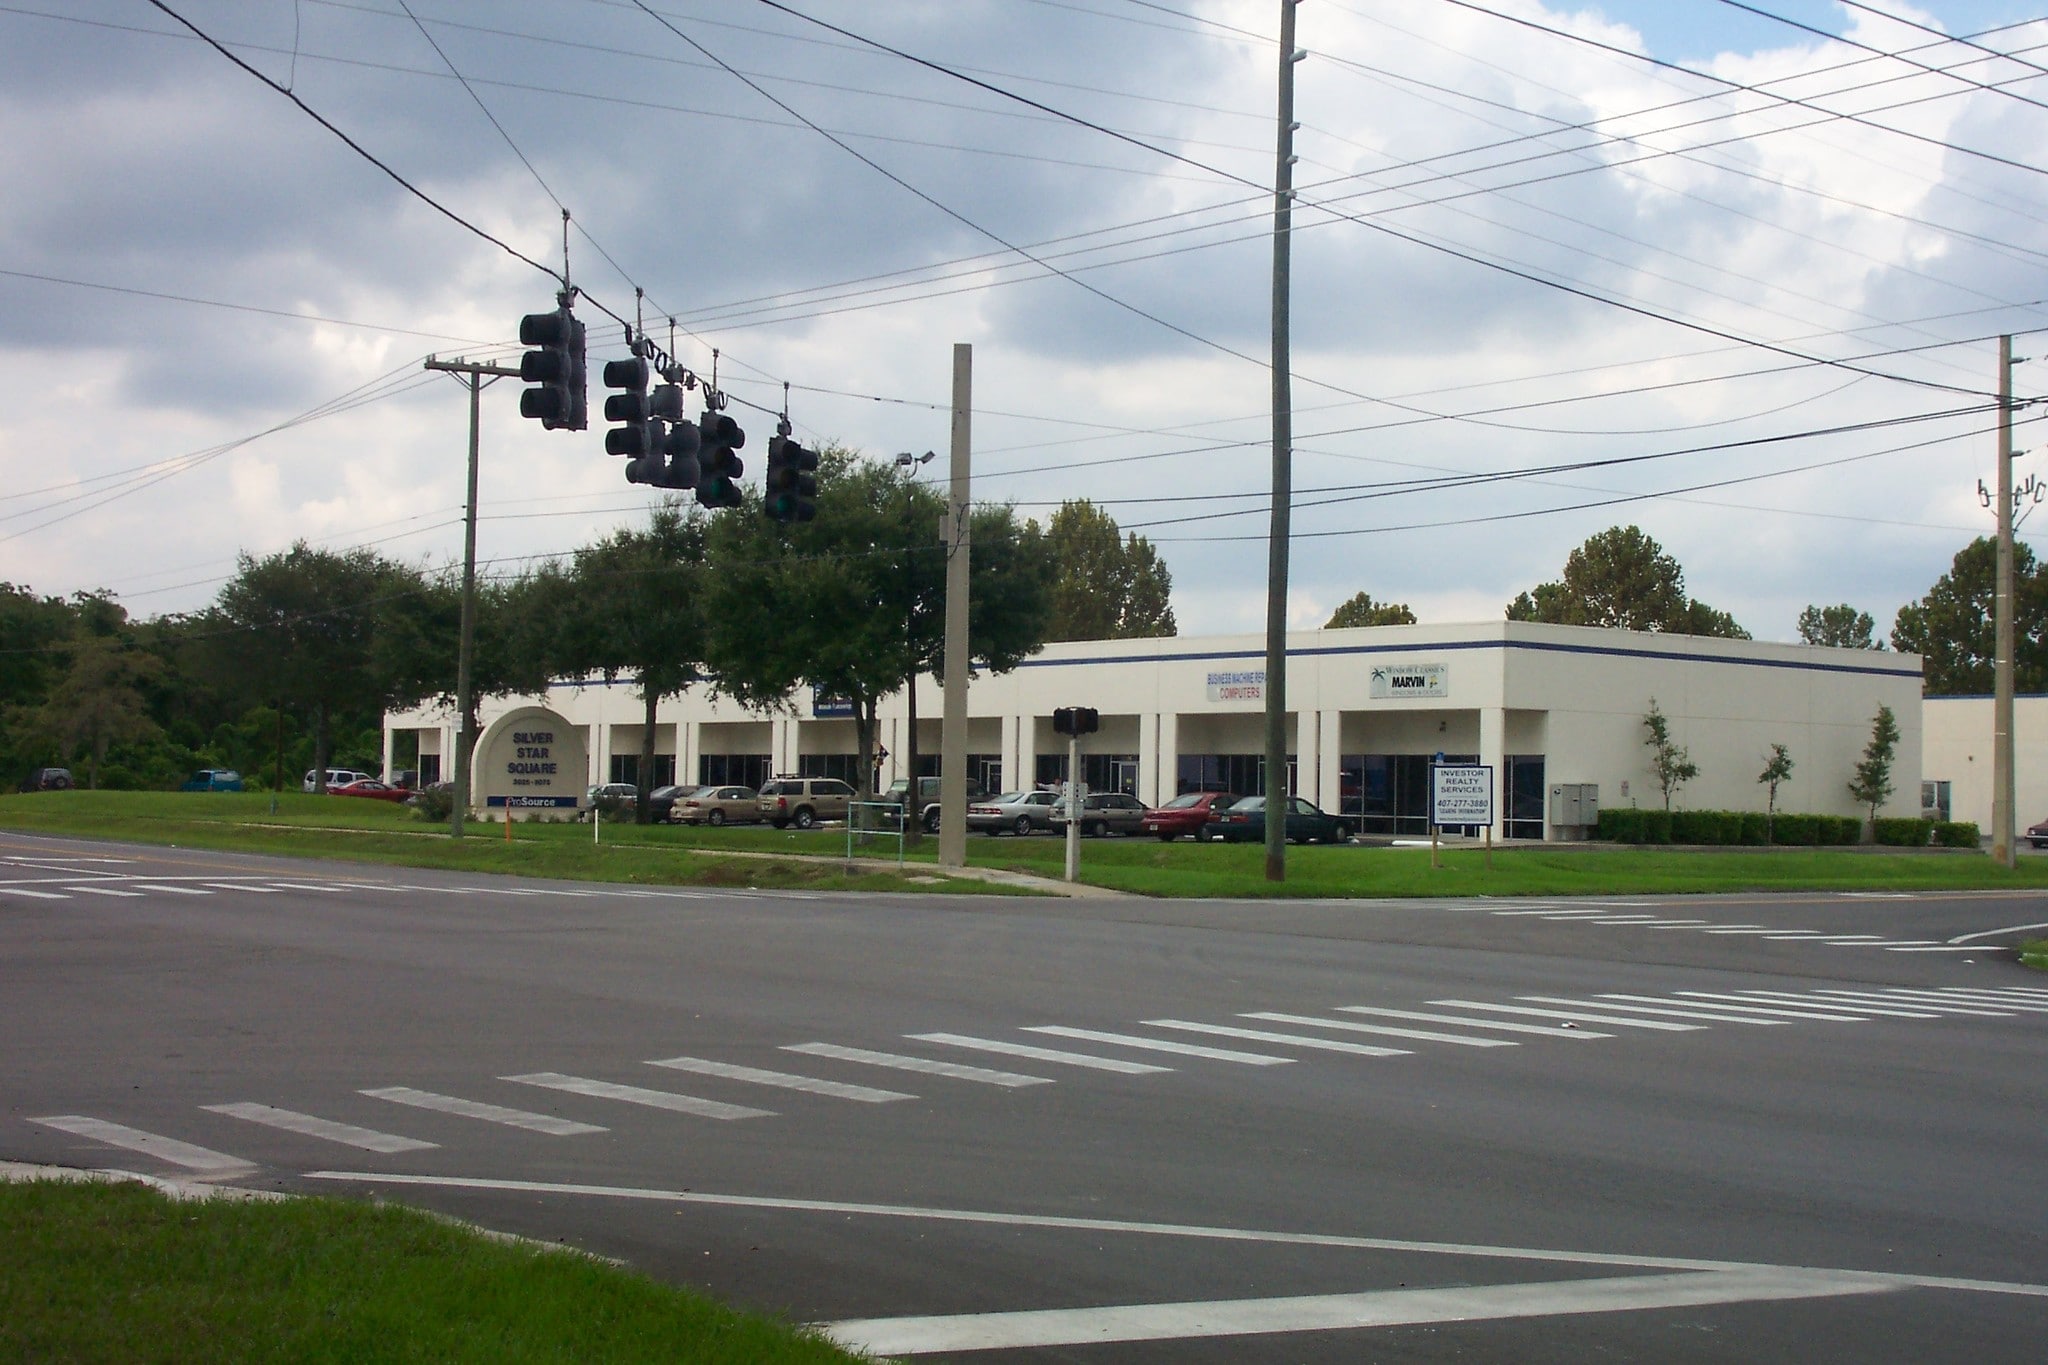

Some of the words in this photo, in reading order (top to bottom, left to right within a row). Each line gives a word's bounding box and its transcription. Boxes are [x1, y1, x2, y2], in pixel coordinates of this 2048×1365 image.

[1207, 673, 1231, 685] BUSINESS
[1232, 672, 1254, 684] MACHINE
[1391, 676, 1425, 688] MARVIN
[1220, 686, 1260, 699] COMPUTERS
[513, 732, 553, 744] SILVER
[517, 747, 549, 759] STAR
[507, 762, 557, 774] SQUARE
[507, 797, 556, 807] ProSource
